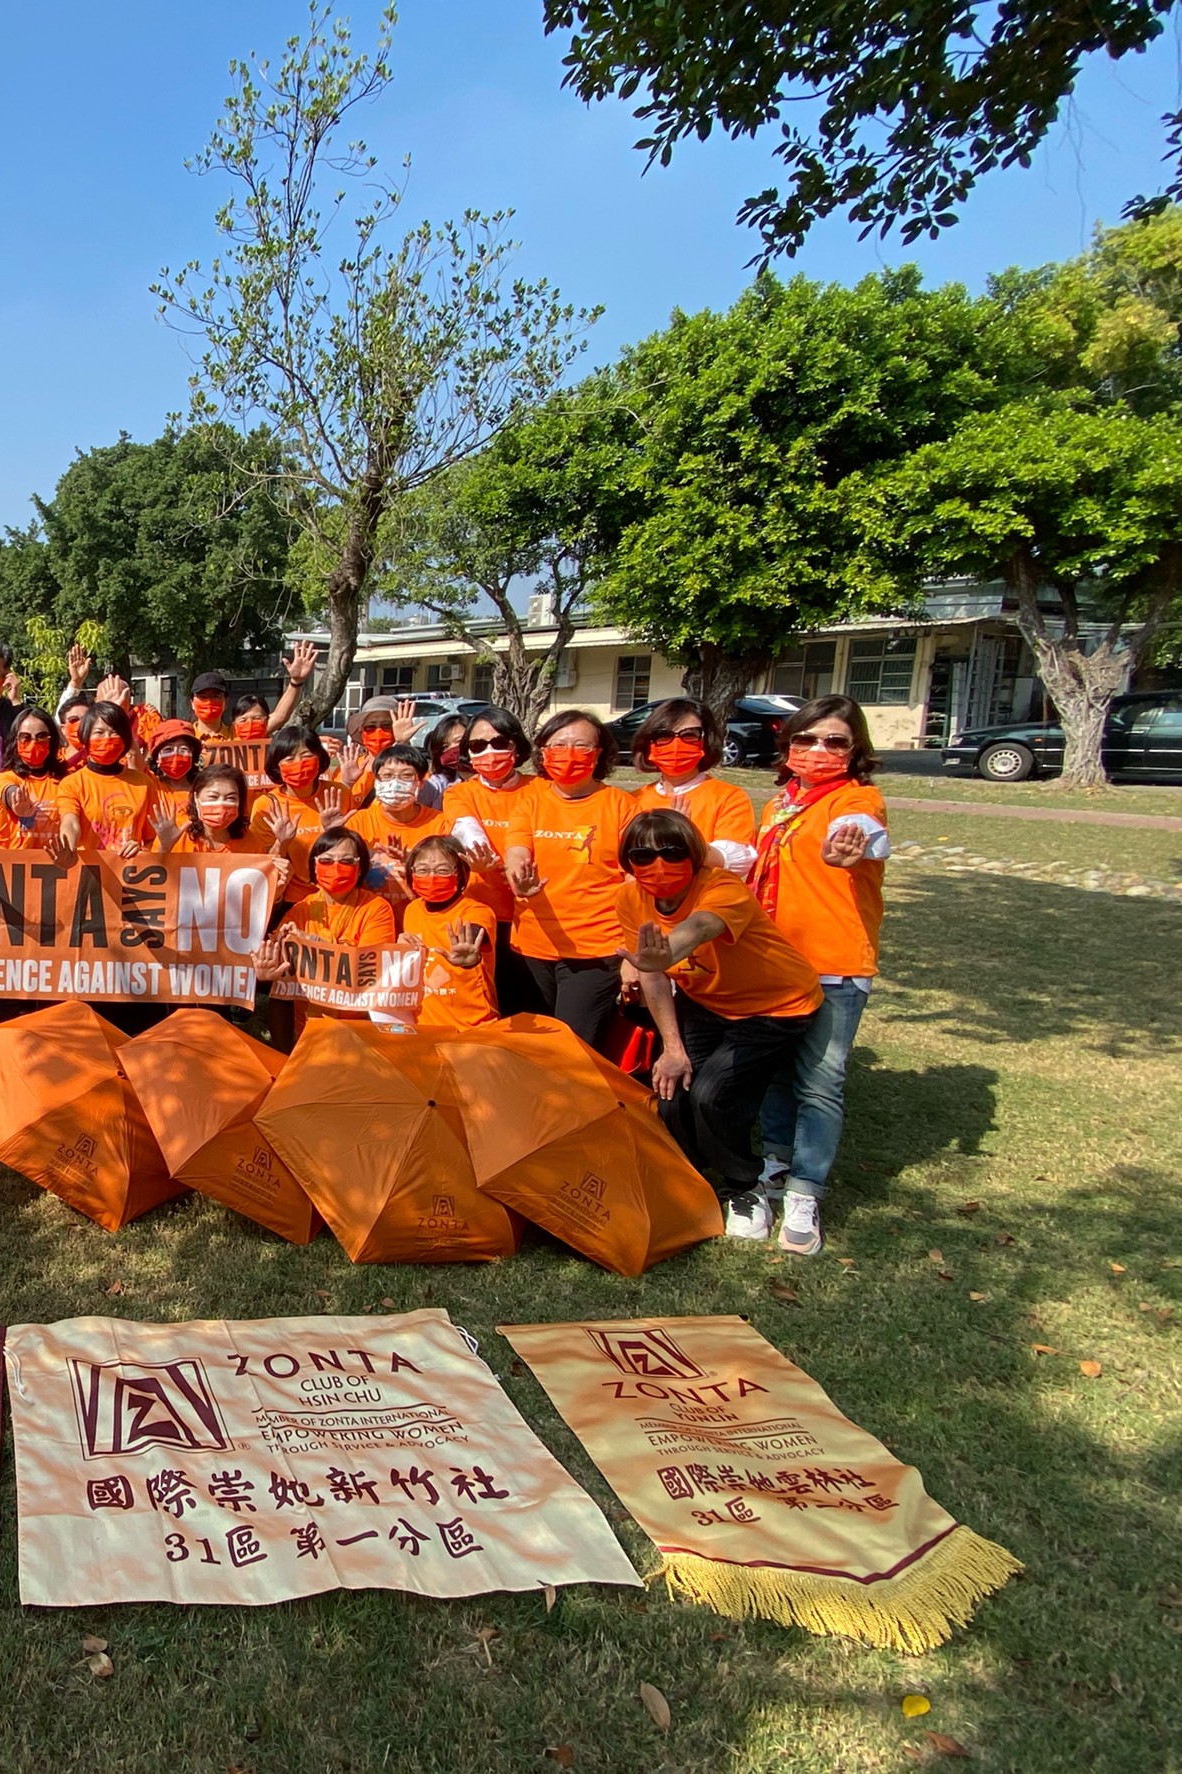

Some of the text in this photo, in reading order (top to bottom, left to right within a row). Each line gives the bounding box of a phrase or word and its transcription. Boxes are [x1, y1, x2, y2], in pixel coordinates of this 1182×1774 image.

[208, 744, 269, 772] ZONT
[296, 826, 325, 836] ONT
[534, 830, 583, 840] ZONTA
[119, 864, 167, 949] SAYS
[177, 866, 269, 955] NO
[58, 960, 163, 996] AGAINST
[281, 941, 352, 988] ONTA
[358, 951, 377, 987] SAYS
[381, 950, 421, 988] NO
[286, 981, 326, 1002] IOLENCE
[328, 989, 374, 1007] AGAINST
[377, 992, 418, 1007] WOMEN
[58, 1143, 98, 1176] ZONTA
[238, 1158, 281, 1188] ZONTA
[560, 1181, 610, 1221] ZONTA
[418, 1217, 469, 1231] ZONTA
[227, 1350, 424, 1379] ZONTA
[300, 1374, 370, 1392] CLUB OF
[602, 1377, 770, 1406] ZONTA
[299, 1388, 382, 1407] HSIN CHU
[669, 1402, 727, 1415] CLUB OF
[300, 1417, 318, 1426] OF
[319, 1416, 359, 1427] ZONTA
[360, 1409, 450, 1425] INTERNATIONAL
[674, 1412, 740, 1423] YUNLIN
[726, 1422, 804, 1437] INTERNATIONAL
[261, 1421, 464, 1444] EMPOWERING WOMEN
[399, 1434, 470, 1450] ADVOCACY
[648, 1433, 818, 1452] EMPOWERING WOMEN
[657, 1444, 712, 1456] THROUGH
[766, 1447, 825, 1461] ADVOCACY
[87, 1465, 510, 1519] 國際崇她新竹社
[656, 1463, 876, 1500] 國際崇她雲林社
[691, 1496, 761, 1526] 31區
[164, 1516, 484, 1568] 31區 第一分區
